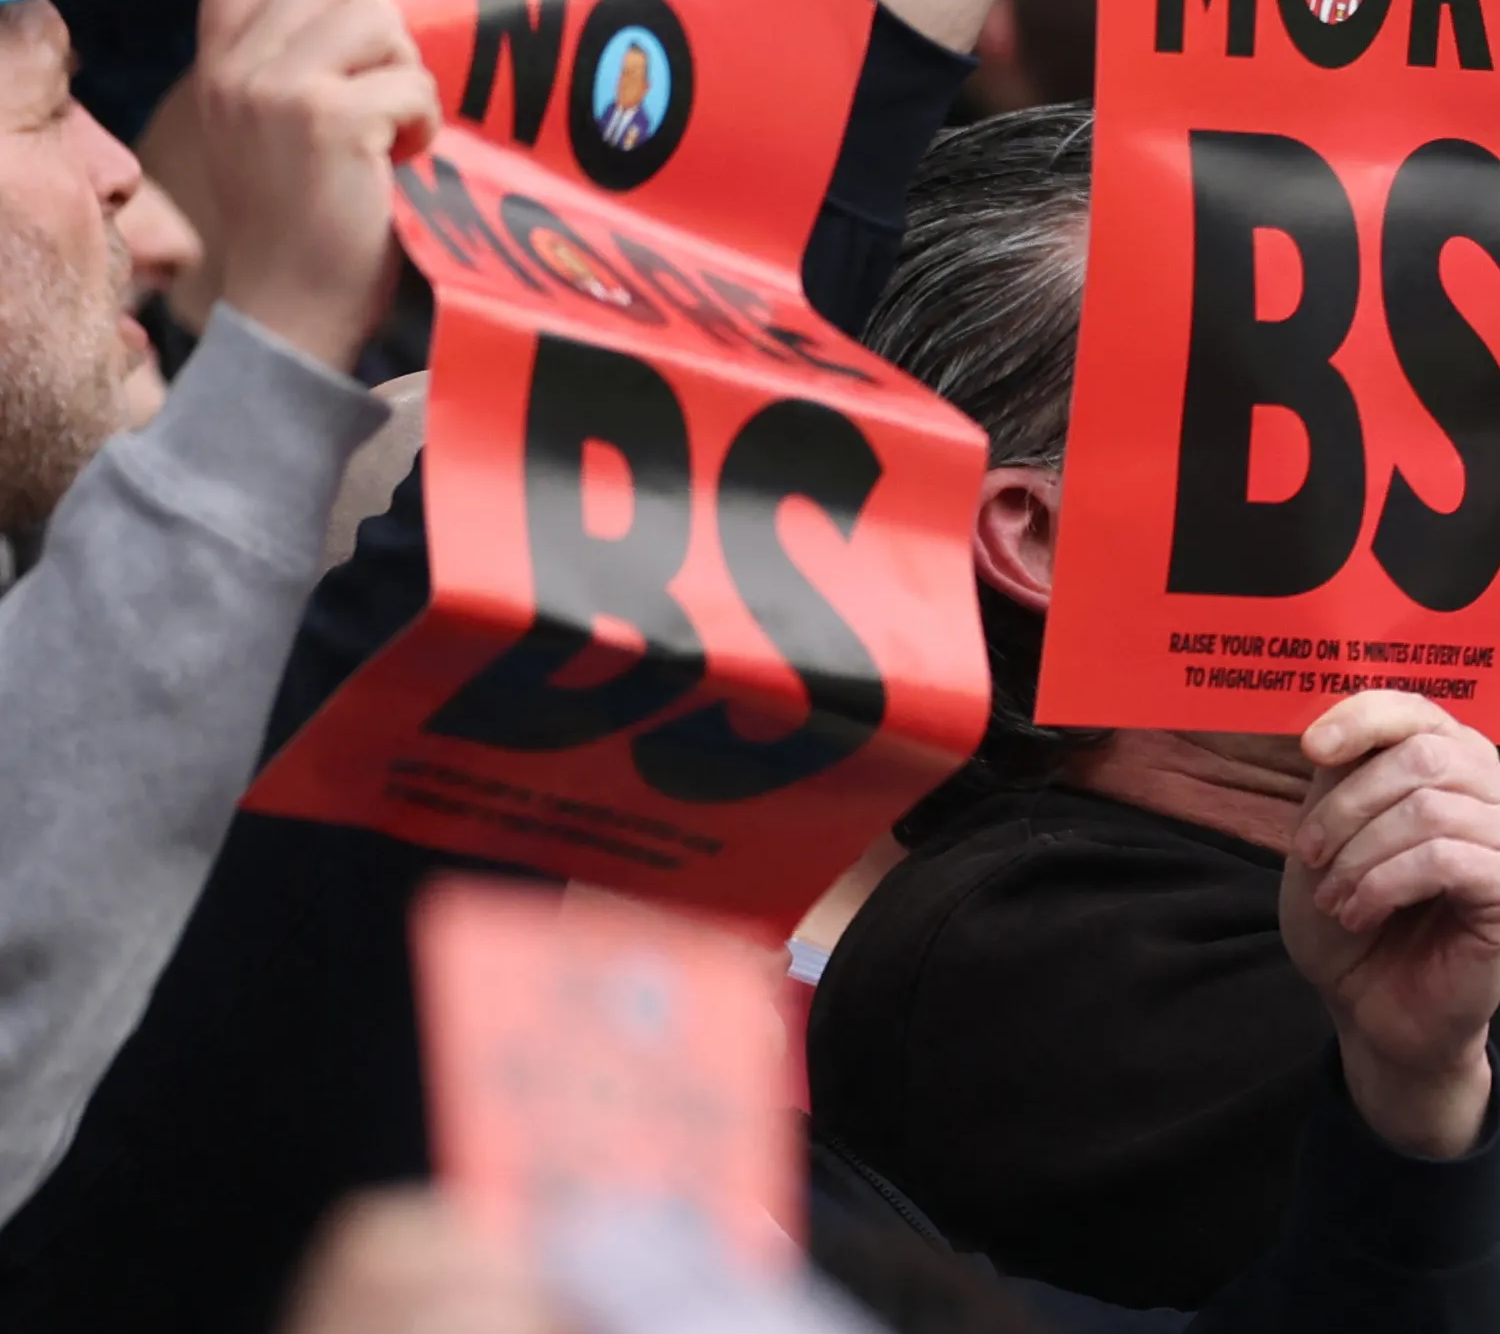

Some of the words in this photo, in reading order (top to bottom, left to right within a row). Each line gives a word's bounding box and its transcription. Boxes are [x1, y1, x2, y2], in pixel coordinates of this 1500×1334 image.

[393, 154, 885, 387] MORE
[424, 329, 886, 805] BS
[1169, 633, 1216, 655] RAISE
[1221, 633, 1264, 657] YOUR
[1268, 637, 1312, 659] CARD
[1317, 639, 1340, 660] ON
[1347, 640, 1360, 661] 15
[1364, 641, 1408, 664] MINUTES
[1410, 643, 1425, 664] AT
[1426, 644, 1461, 666] EVERY
[1463, 646, 1495, 668] GAME
[1186, 666, 1205, 688] TO
[1208, 667, 1296, 692] HIGHLIGHT
[1298, 671, 1315, 692] 15
[1320, 673, 1369, 696] YEARS
